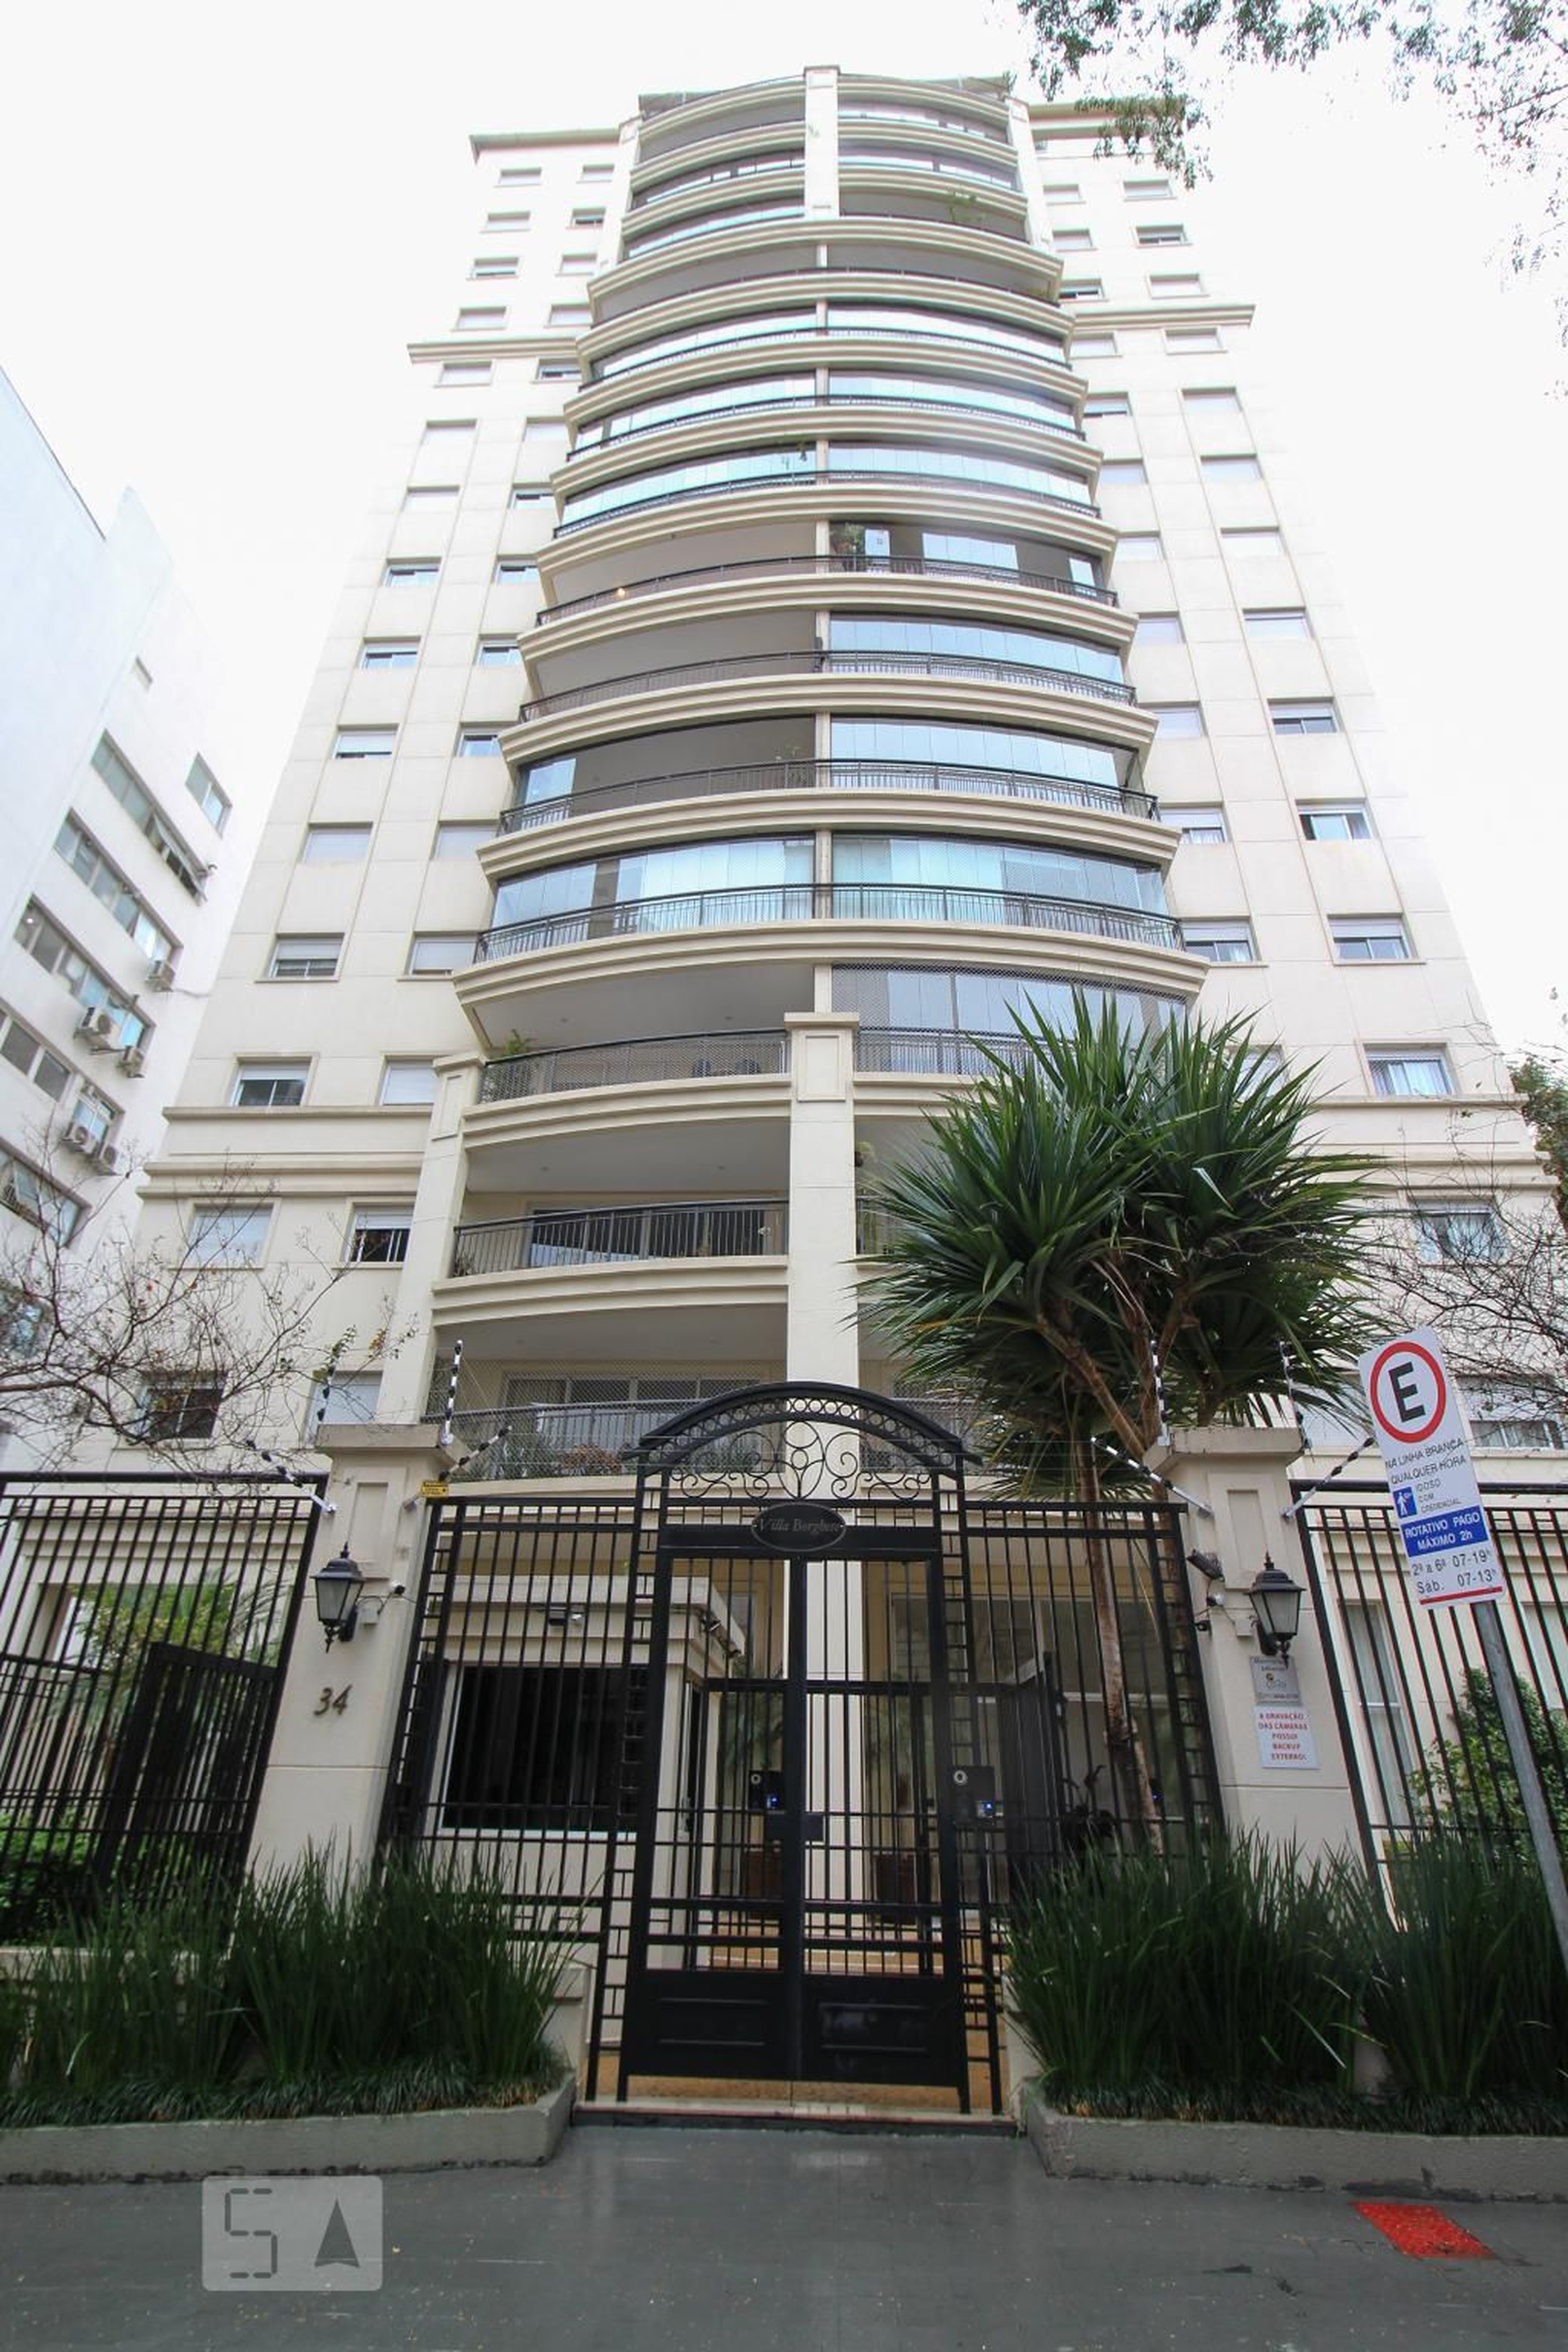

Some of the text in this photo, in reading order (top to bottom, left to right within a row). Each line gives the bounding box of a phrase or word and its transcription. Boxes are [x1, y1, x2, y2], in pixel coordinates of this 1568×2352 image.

[1388, 1361, 1426, 1422] E
[1385, 1438, 1464, 1469] NA LINHA BRANCA
[1391, 1455, 1466, 1484] QUALQUER HORA
[760, 1519, 788, 1531] Villa
[1405, 1512, 1480, 1539] ROTATIVO PAGO
[1460, 1530, 1472, 1541] 2h
[314, 1684, 353, 1716] 34
